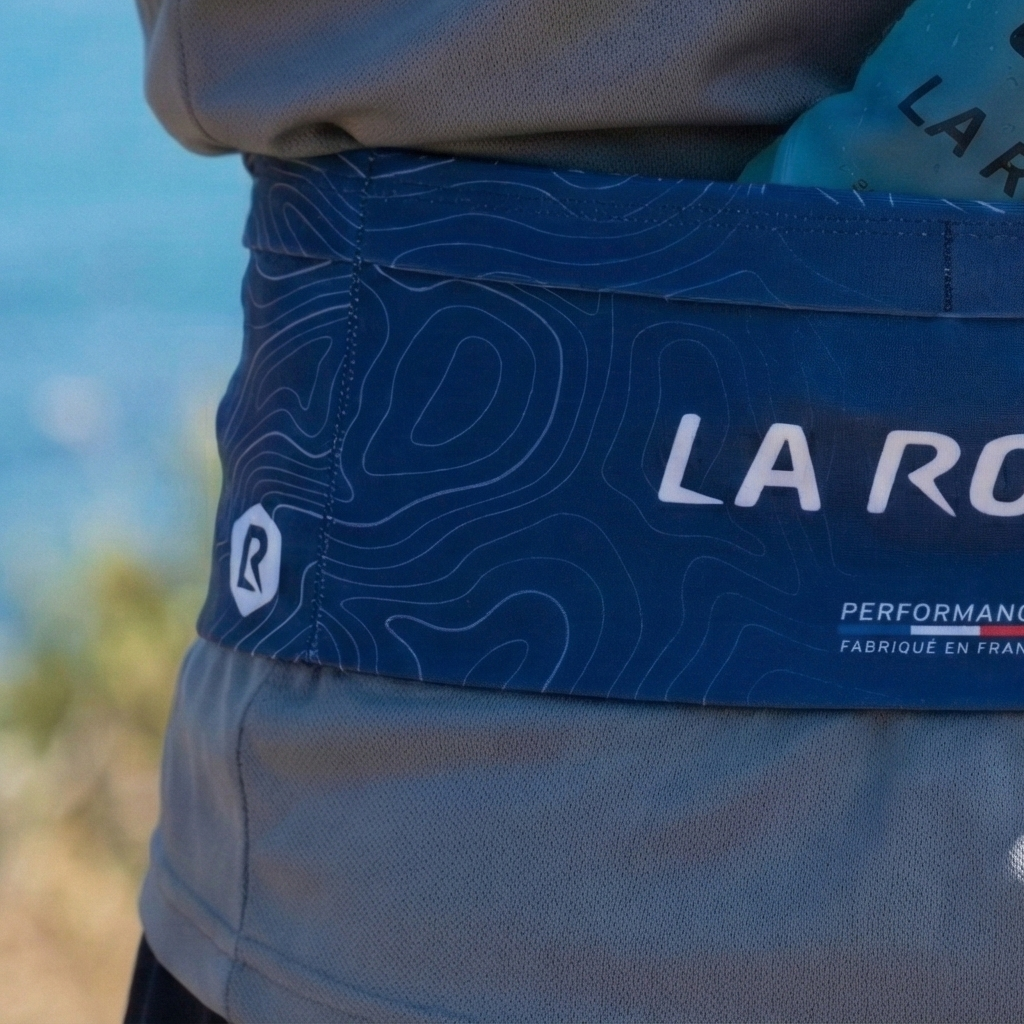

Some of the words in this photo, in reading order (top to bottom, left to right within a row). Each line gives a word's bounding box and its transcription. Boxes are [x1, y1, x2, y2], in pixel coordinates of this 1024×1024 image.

[897, 74, 987, 159] LA
[657, 413, 822, 512] LA
[236, 523, 269, 594] R
[839, 637, 937, 655] FABRIQUÉ
[944, 641, 969, 655] EN
